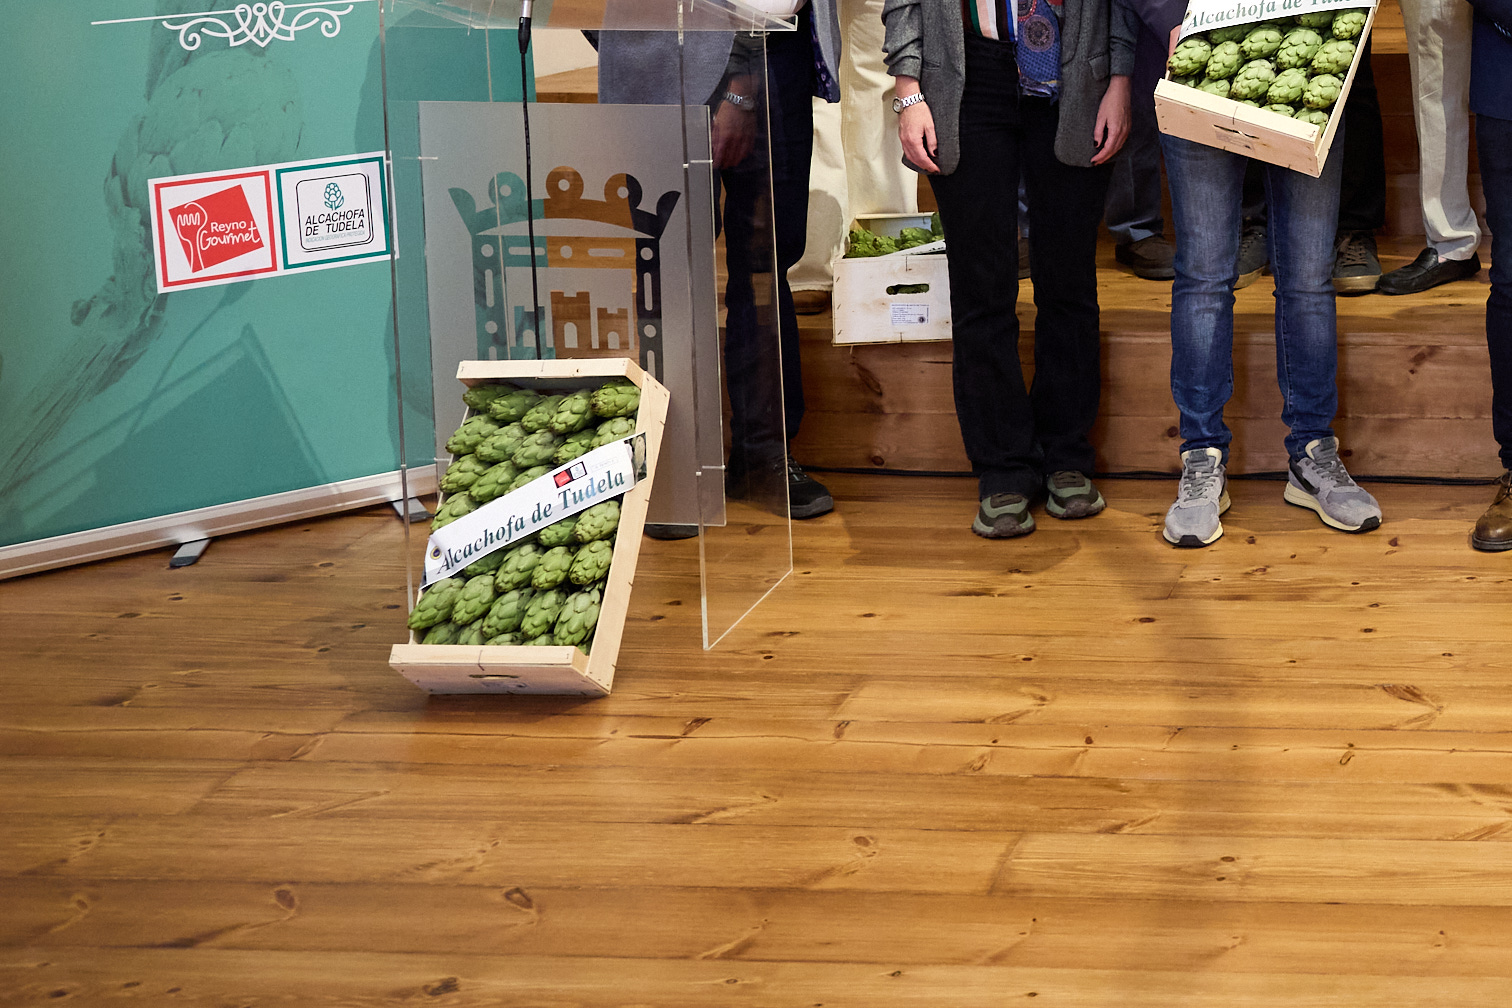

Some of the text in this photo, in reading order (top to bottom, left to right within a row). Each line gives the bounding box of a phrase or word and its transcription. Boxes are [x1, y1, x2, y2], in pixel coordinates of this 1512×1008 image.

[1188, 0, 1276, 29] Alcachofa
[210, 220, 247, 234] Reyno
[305, 208, 365, 226] ALCACHOFA
[305, 219, 364, 237] DE TUDELA
[200, 221, 260, 250] Gourmet
[437, 469, 625, 574] Alcachofa de Tudela
